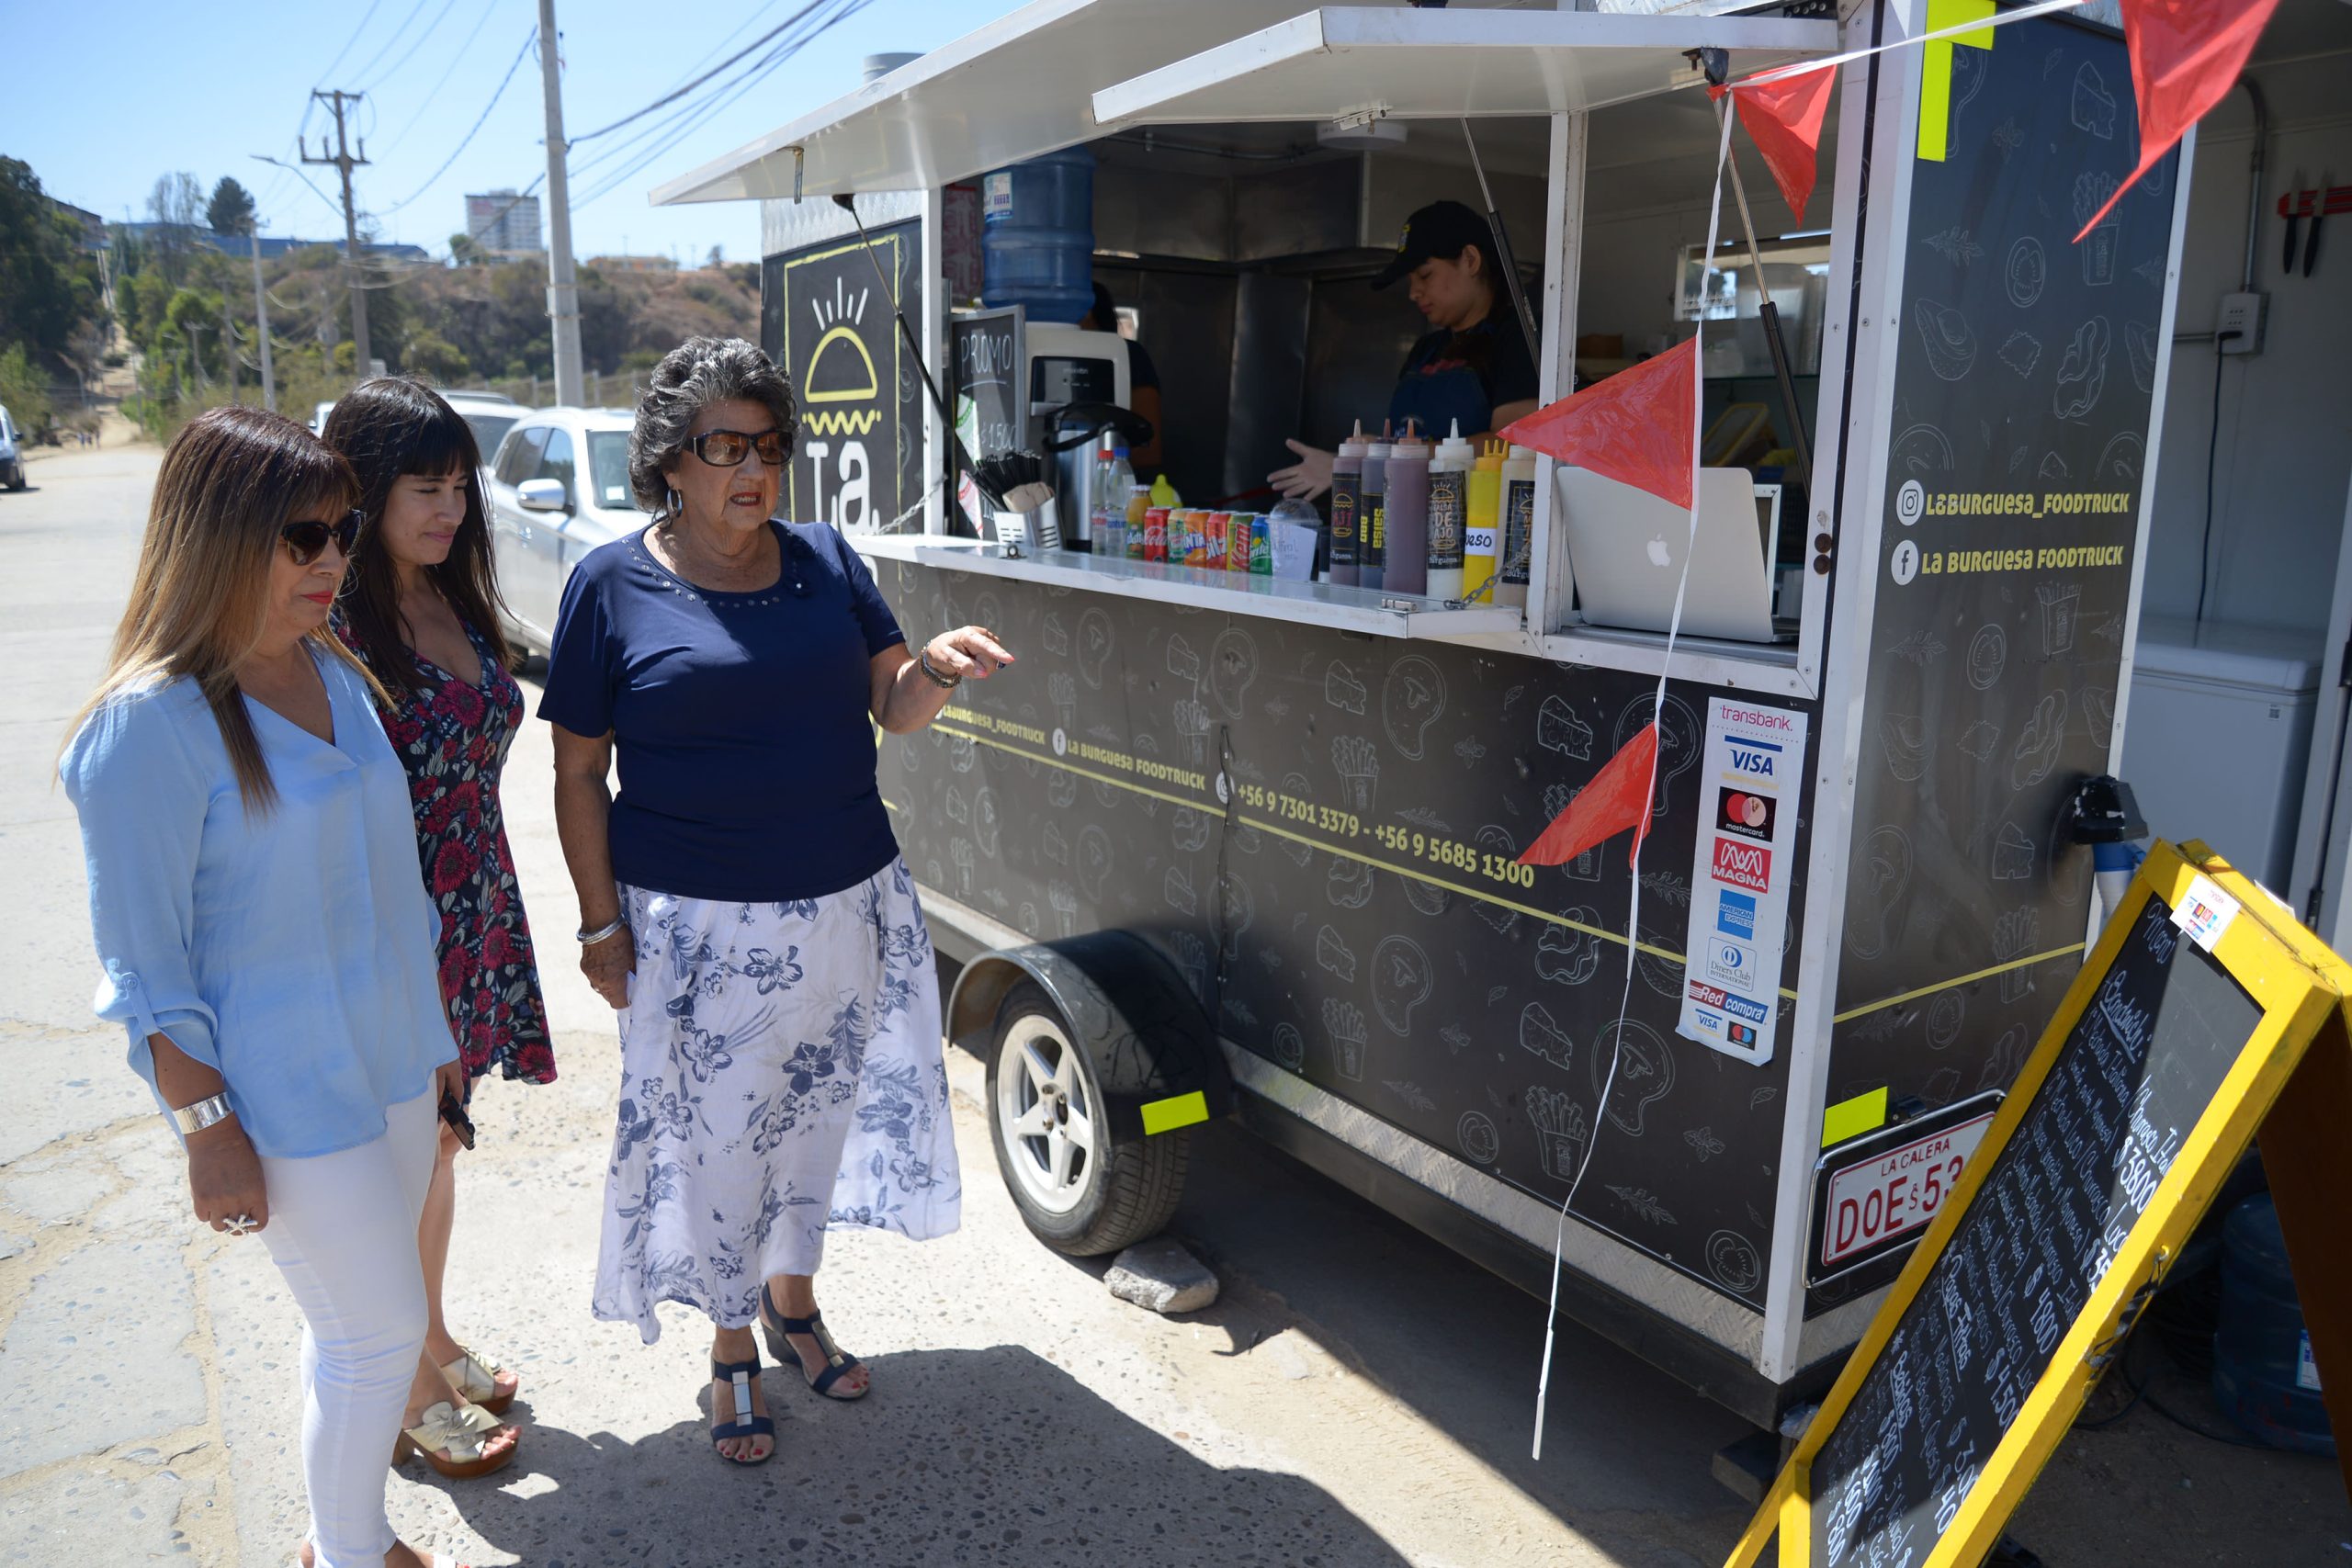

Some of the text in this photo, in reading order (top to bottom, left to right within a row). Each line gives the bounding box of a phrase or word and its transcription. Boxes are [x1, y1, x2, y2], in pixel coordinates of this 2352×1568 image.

[961, 334, 1012, 376] PROMO
[1434, 512, 1453, 527] DE
[1434, 528, 1453, 539] AJO
[1921, 553, 1942, 574] La
[2037, 546, 2124, 570] FOODTRUCK
[1068, 739, 1078, 755] La
[1136, 759, 1205, 791] FOODTRUCK
[1729, 749, 1773, 776] VISA
[1238, 784, 1263, 807] +56
[1266, 792, 1276, 812] 9
[1279, 795, 1316, 824] 7301
[1319, 807, 1359, 837] 3379
[1374, 824, 1408, 852] +56
[1412, 833, 1424, 856] 9
[1429, 838, 1476, 873] 5685
[1482, 853, 1534, 888] 1300
[1713, 865, 1767, 889] MAGNA
[1724, 913, 1754, 928] EXPRESS
[1711, 961, 1751, 981] Diners Club
[1701, 987, 1764, 1021] Red compra
[1699, 1015, 1717, 1030] VISA
[1882, 1137, 1950, 1177] LA CALERA
[1835, 1176, 1907, 1253] DOE
